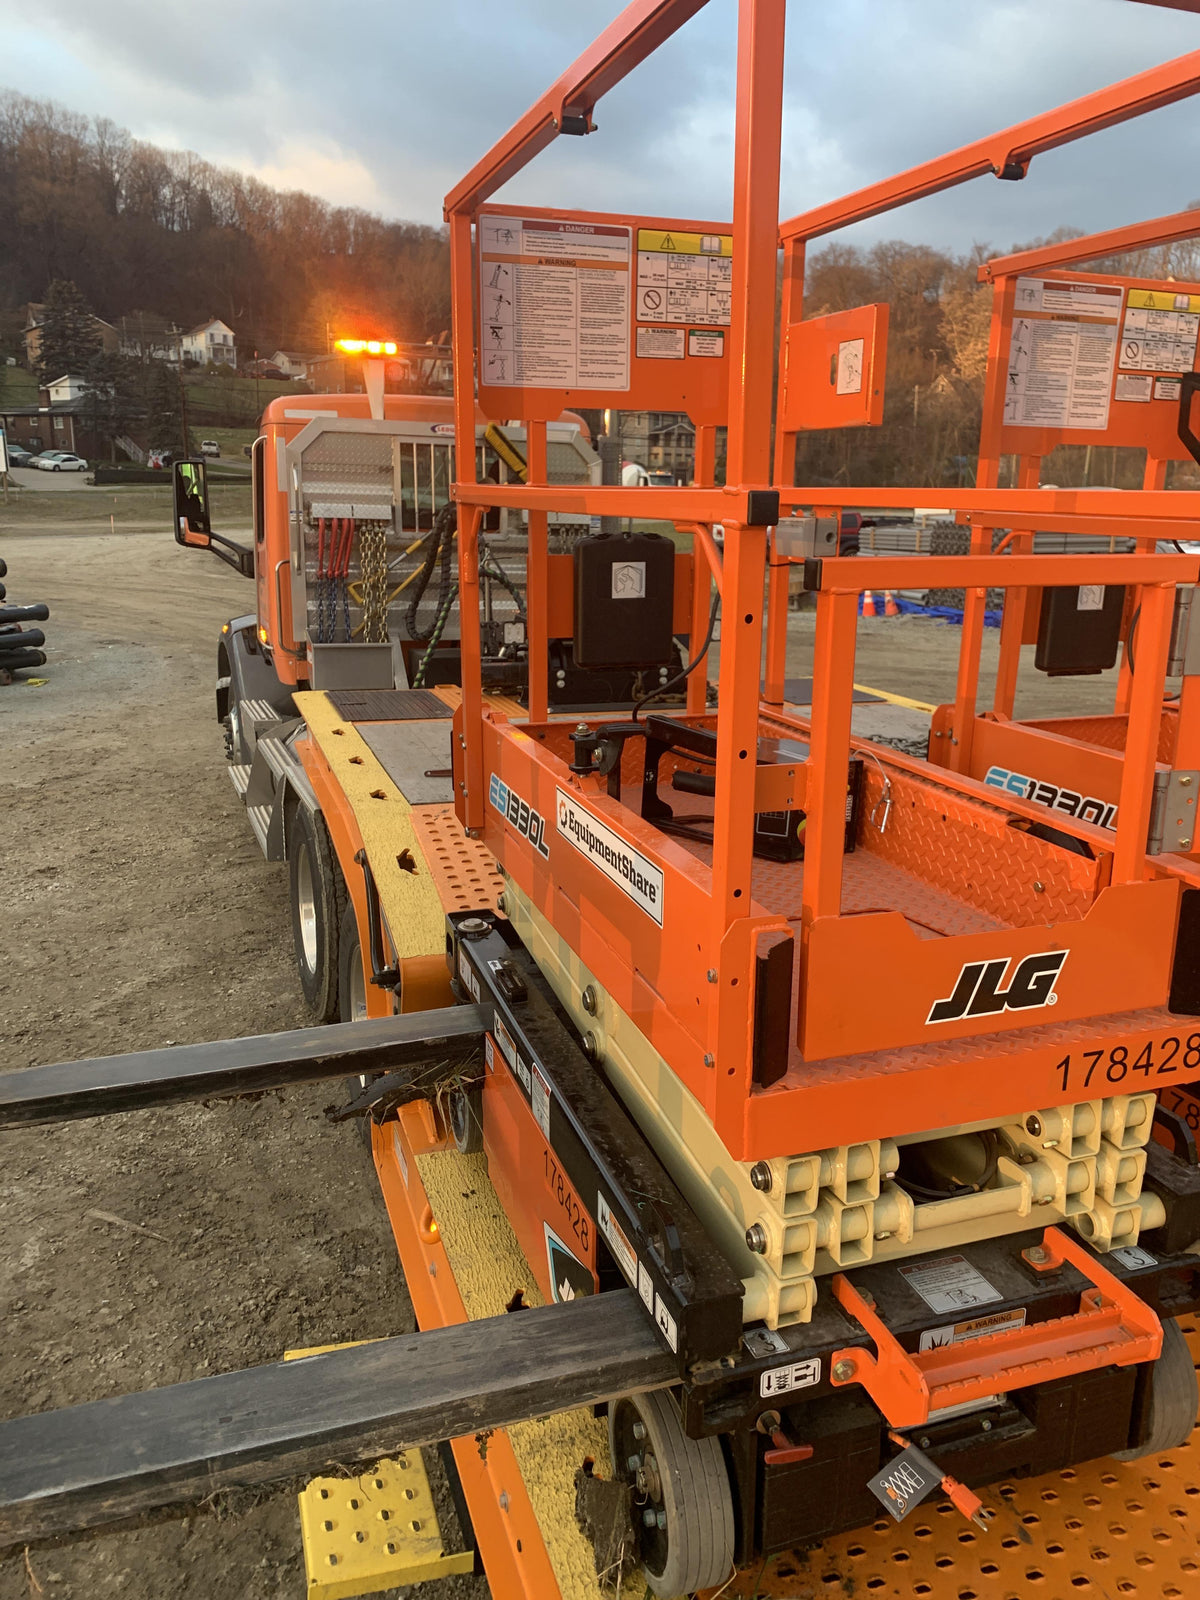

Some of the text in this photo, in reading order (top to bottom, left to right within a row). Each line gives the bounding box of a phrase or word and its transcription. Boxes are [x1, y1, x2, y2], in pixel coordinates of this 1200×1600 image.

[544, 258, 577, 267] WARNING
[565, 225, 594, 234] DANGER
[489, 773, 550, 861] ES1330L
[568, 808, 656, 904] EquipmentShare
[925, 950, 1070, 1024] JLG
[1056, 1032, 1200, 1091] 178428
[543, 1150, 589, 1252] 178428
[975, 1313, 1012, 1328] WARNING
